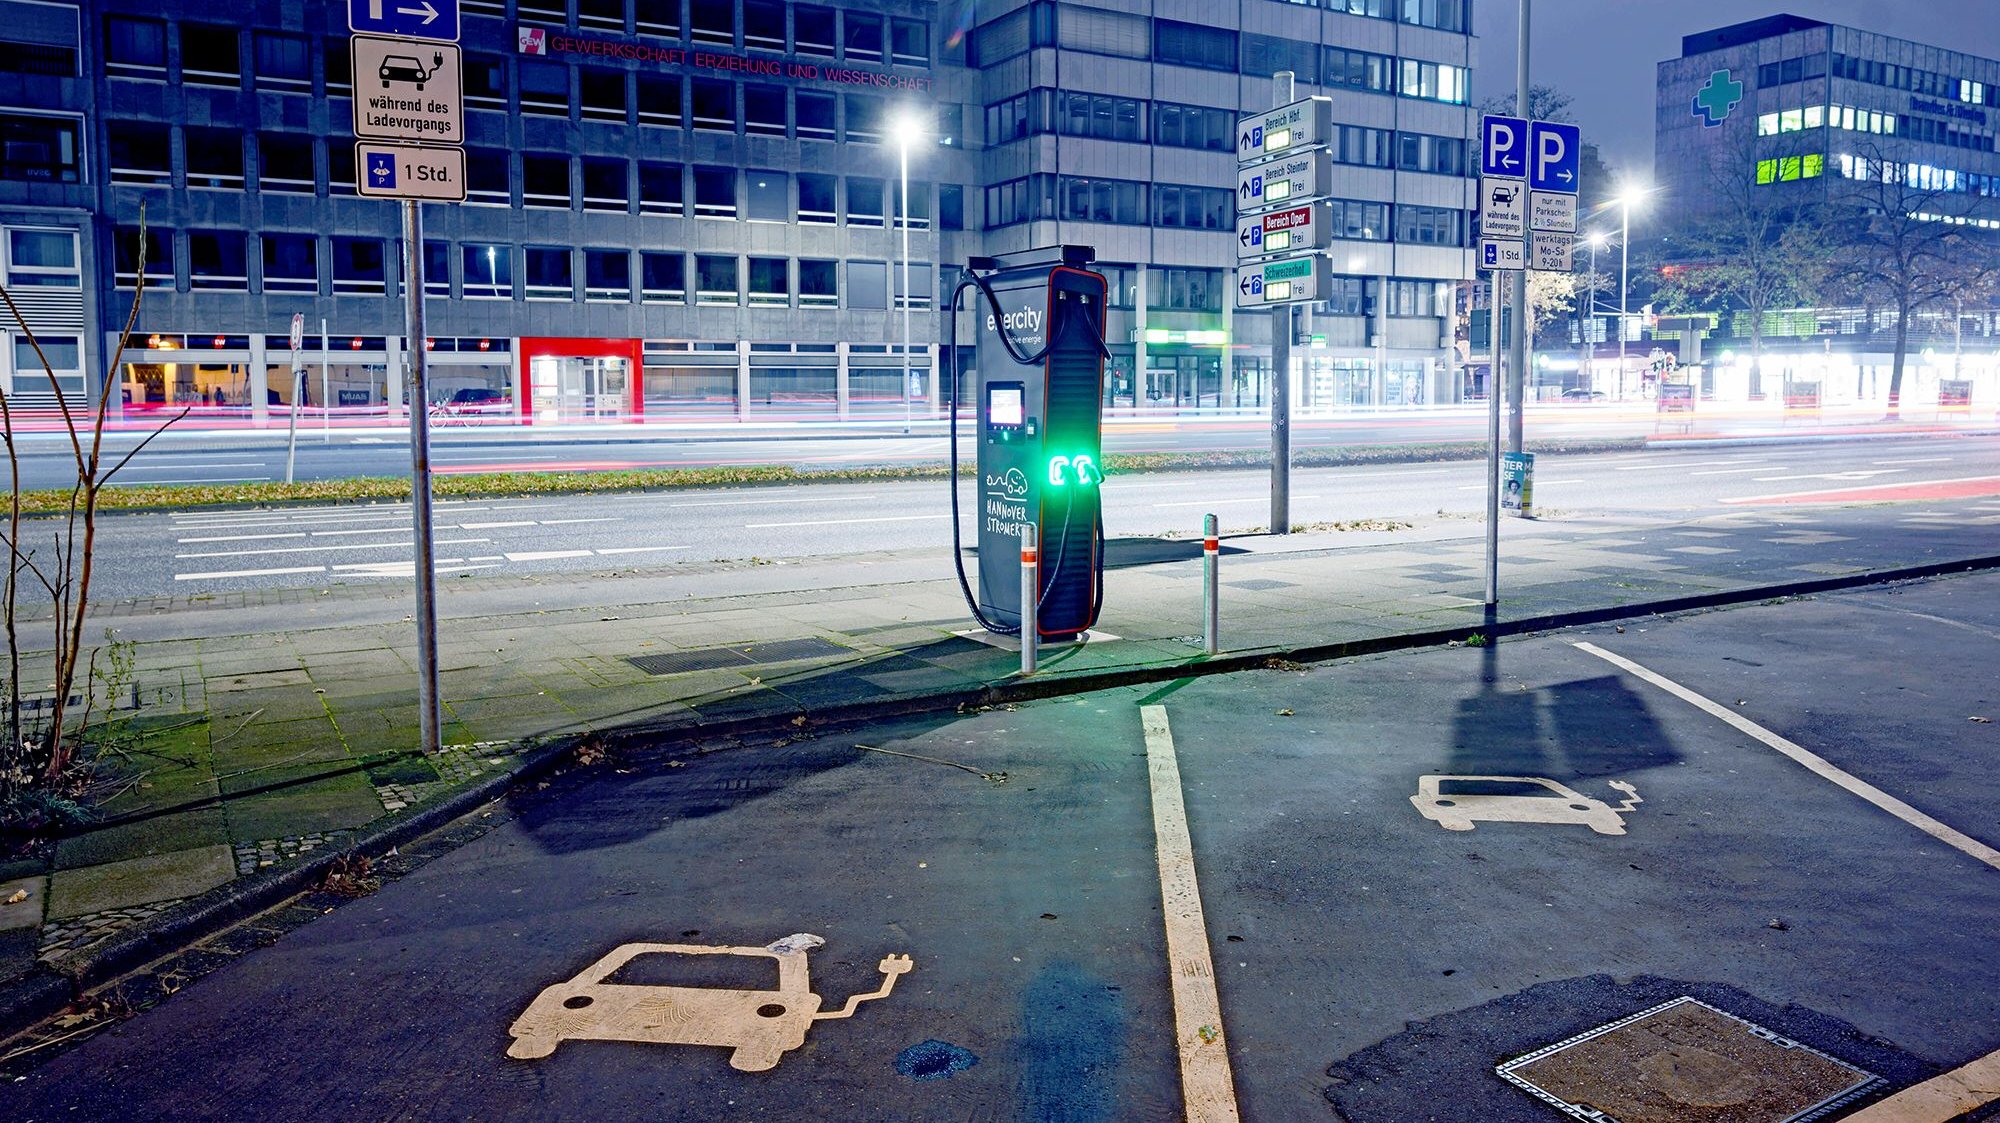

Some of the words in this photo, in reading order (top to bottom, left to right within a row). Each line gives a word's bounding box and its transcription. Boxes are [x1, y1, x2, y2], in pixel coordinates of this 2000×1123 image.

[519, 38, 545, 46] GEW
[551, 36, 688, 65] GEWERKSCHAFT
[695, 52, 781, 76] ERZIEHUNG
[788, 66, 818, 79] UND
[825, 67, 933, 93] WISSENSCHAFT
[369, 96, 421, 112] während
[427, 100, 449, 114] des
[367, 112, 451, 134] Ladevorgangs
[1265, 113, 1288, 130] Bereich
[1289, 108, 1301, 123] Hbf.
[1292, 128, 1305, 141] frei
[1490, 124, 1514, 167] P
[1539, 131, 1565, 181] P
[405, 164, 412, 180] 1
[417, 164, 452, 182] Std.
[1265, 166, 1285, 180] Bereich
[1286, 161, 1309, 175] Steintor
[1292, 179, 1305, 192] frei
[1487, 211, 1509, 221] während
[1511, 213, 1520, 221] des
[1536, 206, 1572, 217] Parkschein
[1266, 213, 1290, 230] Bereich
[1290, 212, 1306, 227] Oper
[1485, 220, 1521, 233] Ladevorgangs
[1546, 218, 1573, 228] Stunden
[1291, 231, 1304, 244] frei
[1535, 235, 1571, 246] werktags
[1501, 250, 1506, 260] 1
[1506, 250, 1521, 261] Std.
[1540, 246, 1565, 256] Mo-Sa
[1542, 257, 1563, 268] 9-20h
[1265, 262, 1305, 280] Schweizerhof
[1293, 283, 1305, 294] frei
[1022, 334, 1042, 345] energie
[987, 498, 1027, 521] HANNOVER
[987, 517, 1026, 537] STROMER
